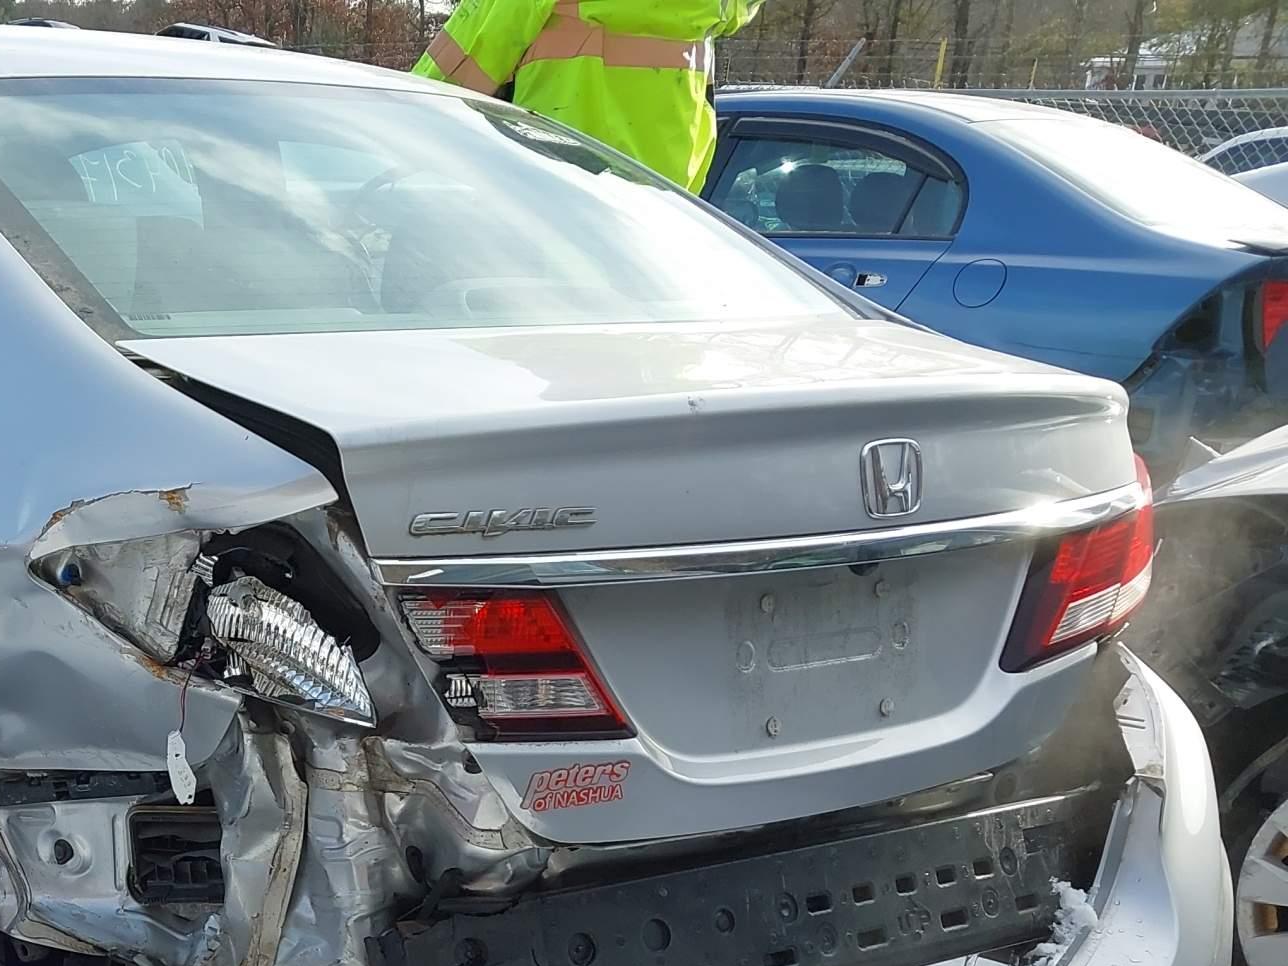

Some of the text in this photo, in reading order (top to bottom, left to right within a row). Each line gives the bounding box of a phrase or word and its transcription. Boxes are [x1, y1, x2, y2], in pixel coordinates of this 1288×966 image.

[409, 507, 599, 537] CIVIC
[520, 761, 631, 809] peters
[534, 783, 624, 811] of NASHUA
